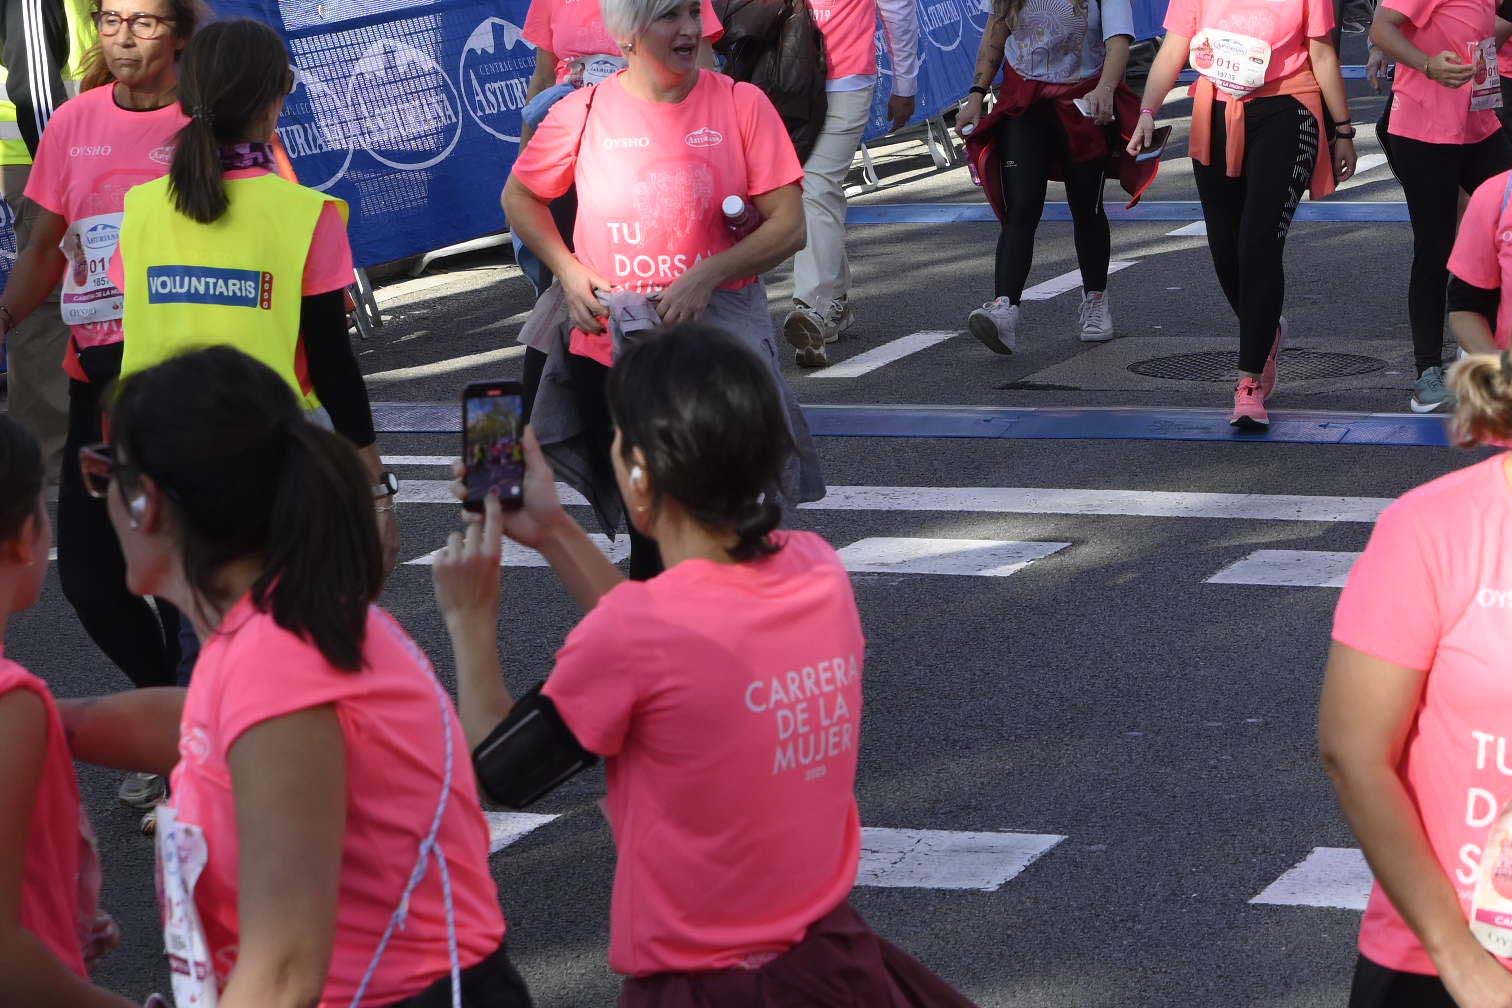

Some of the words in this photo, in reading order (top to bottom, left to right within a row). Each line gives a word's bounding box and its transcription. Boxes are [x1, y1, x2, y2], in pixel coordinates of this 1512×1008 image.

[1216, 57, 1241, 72] 016
[606, 221, 641, 245] TU
[149, 274, 257, 299] VOLUNTARIS
[745, 653, 859, 713] CARRERA
[775, 701, 811, 741] DE
[819, 691, 850, 727] LA
[772, 722, 853, 776] MUJER
